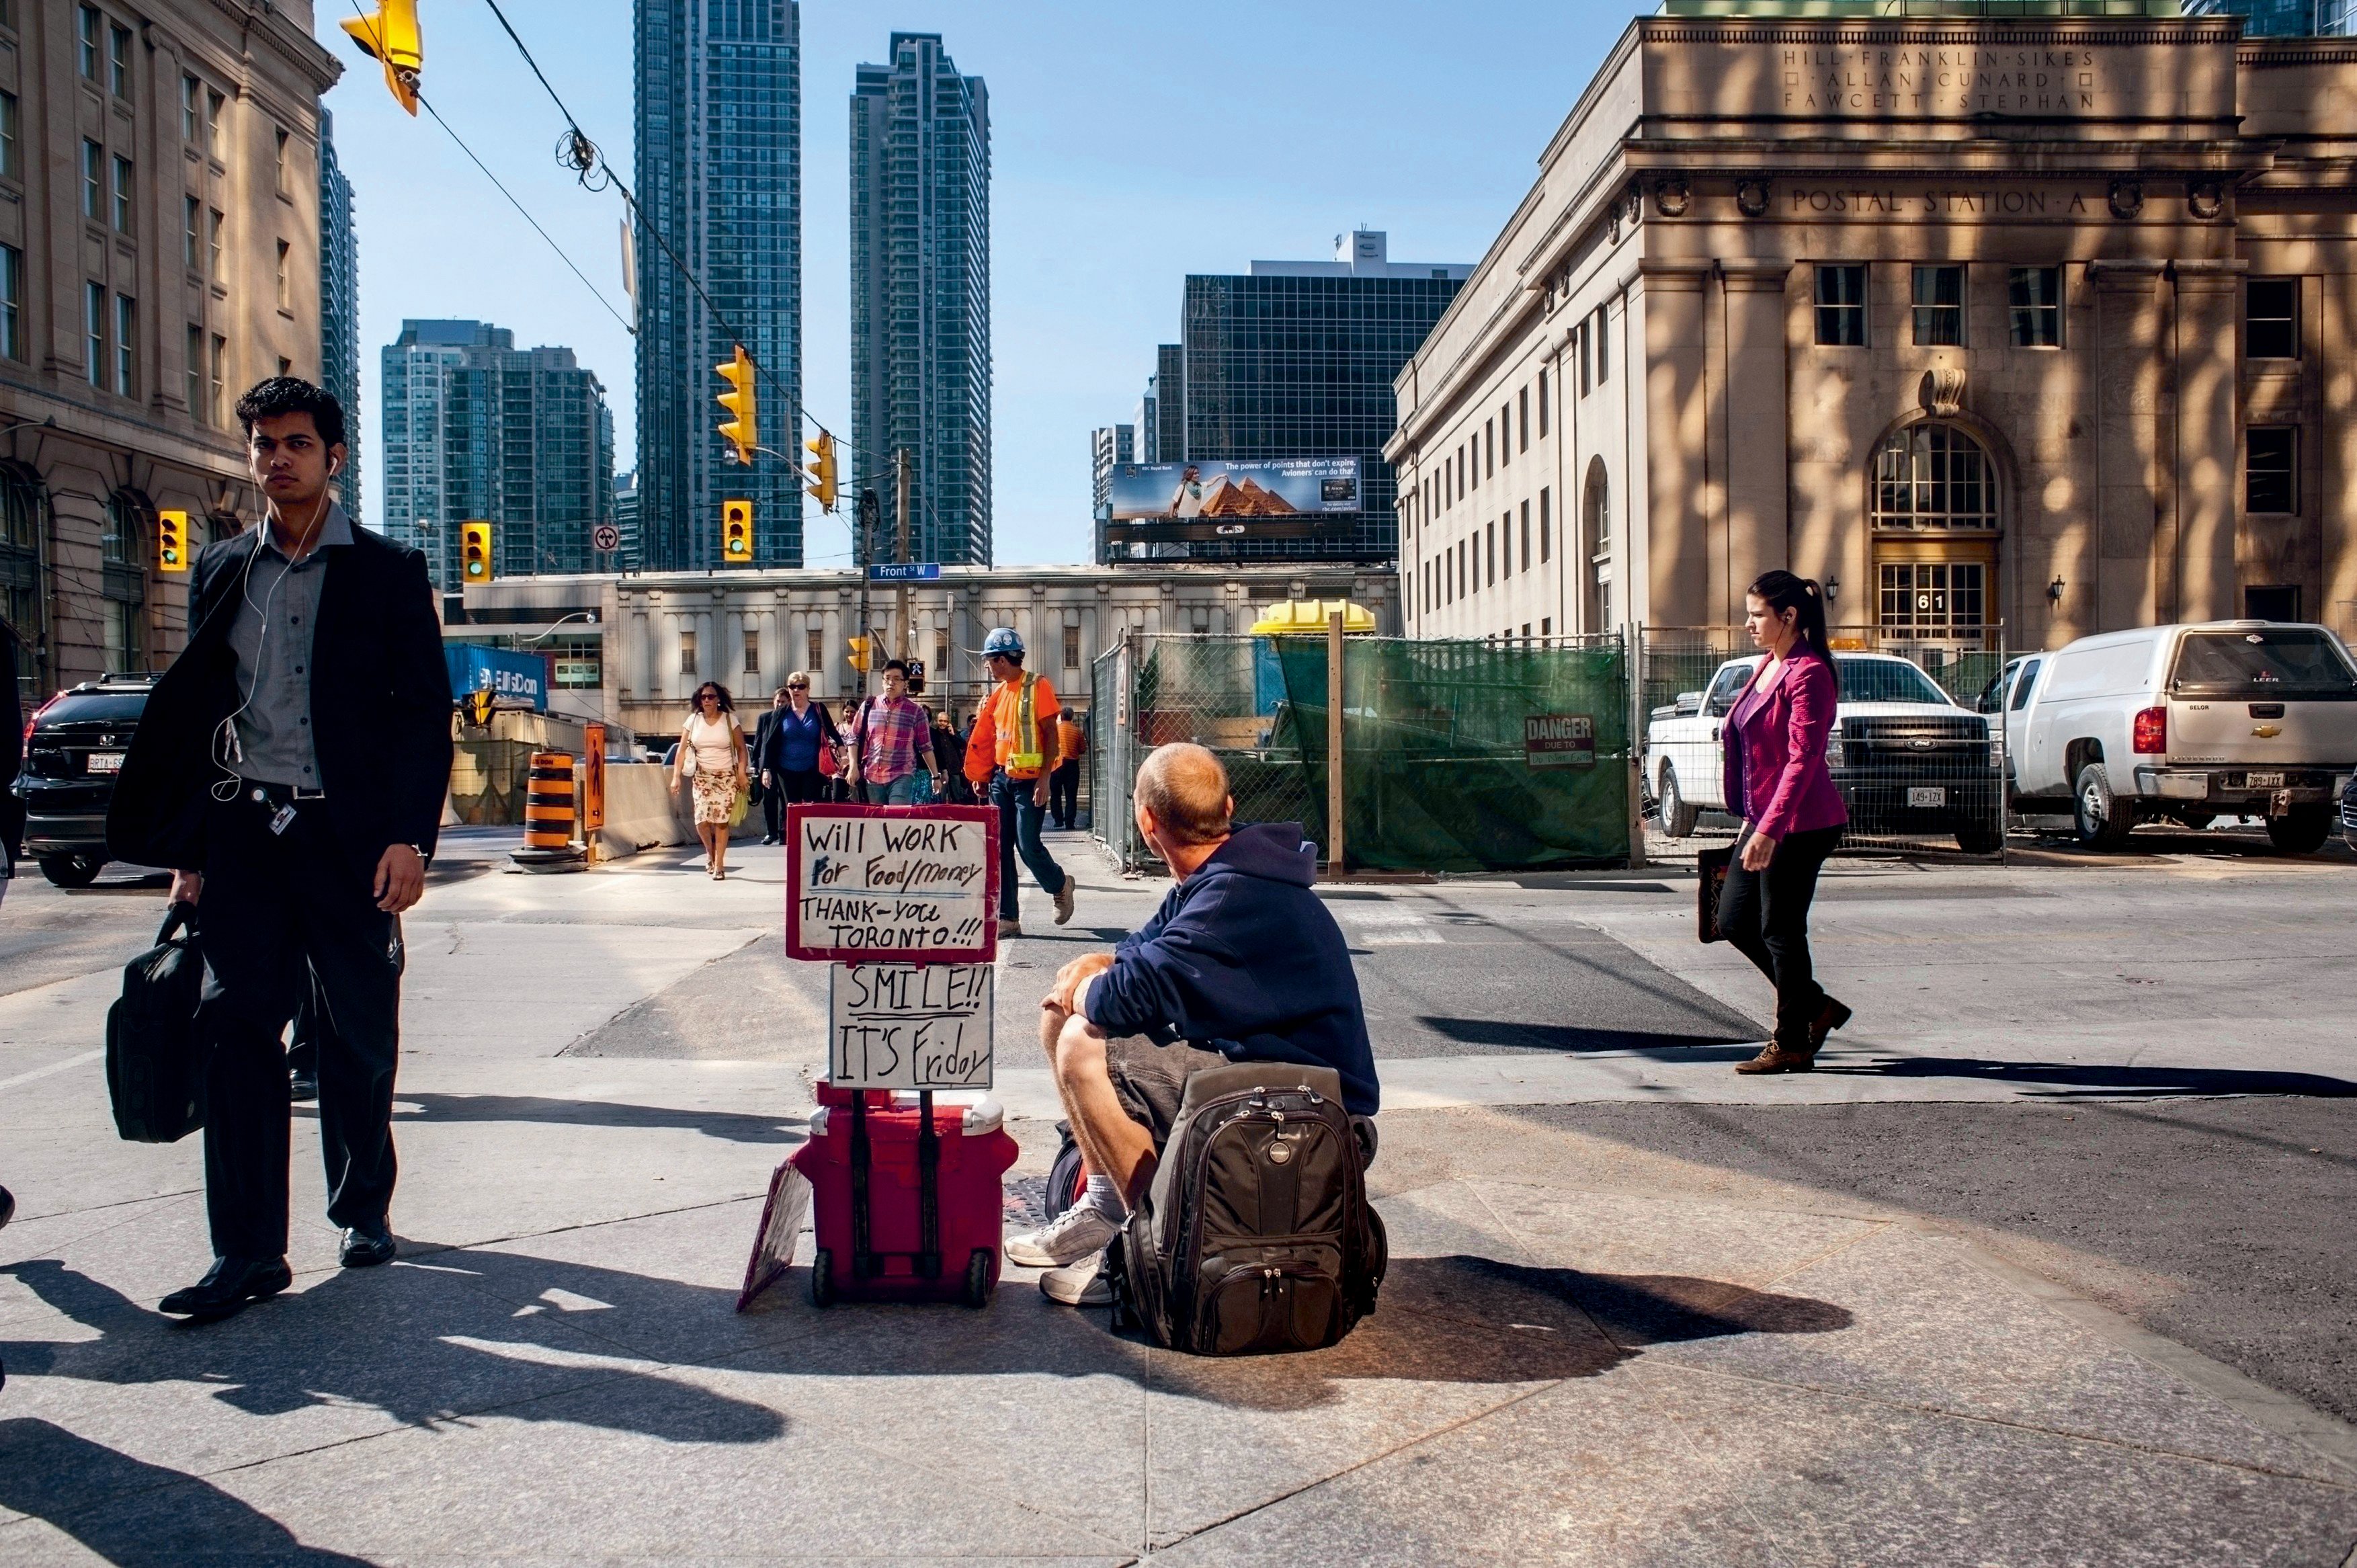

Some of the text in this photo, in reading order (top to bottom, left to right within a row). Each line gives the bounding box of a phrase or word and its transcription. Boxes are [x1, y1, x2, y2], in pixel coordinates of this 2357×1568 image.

[1784, 51, 2092, 66] HILL FRANKLIN SIKES
[1827, 73, 2048, 87] ALLAN CUNARD
[1784, 93, 2092, 108] FAWCETT STEPHAN
[1792, 190, 2087, 212] POSTAL STATION A
[1241, 463, 1262, 471] power
[1272, 461, 1294, 470] points
[1331, 459, 1356, 468] expire.
[880, 567, 907, 577] Front
[917, 565, 925, 575] W
[1918, 595, 1942, 609] 61
[496, 670, 537, 694] EllisDon
[1527, 717, 1591, 740] DANGER
[883, 822, 963, 853] WORK
[811, 855, 849, 887] For
[847, 966, 987, 1009] SMILE!!
[837, 1022, 990, 1083] IT'S Friday
